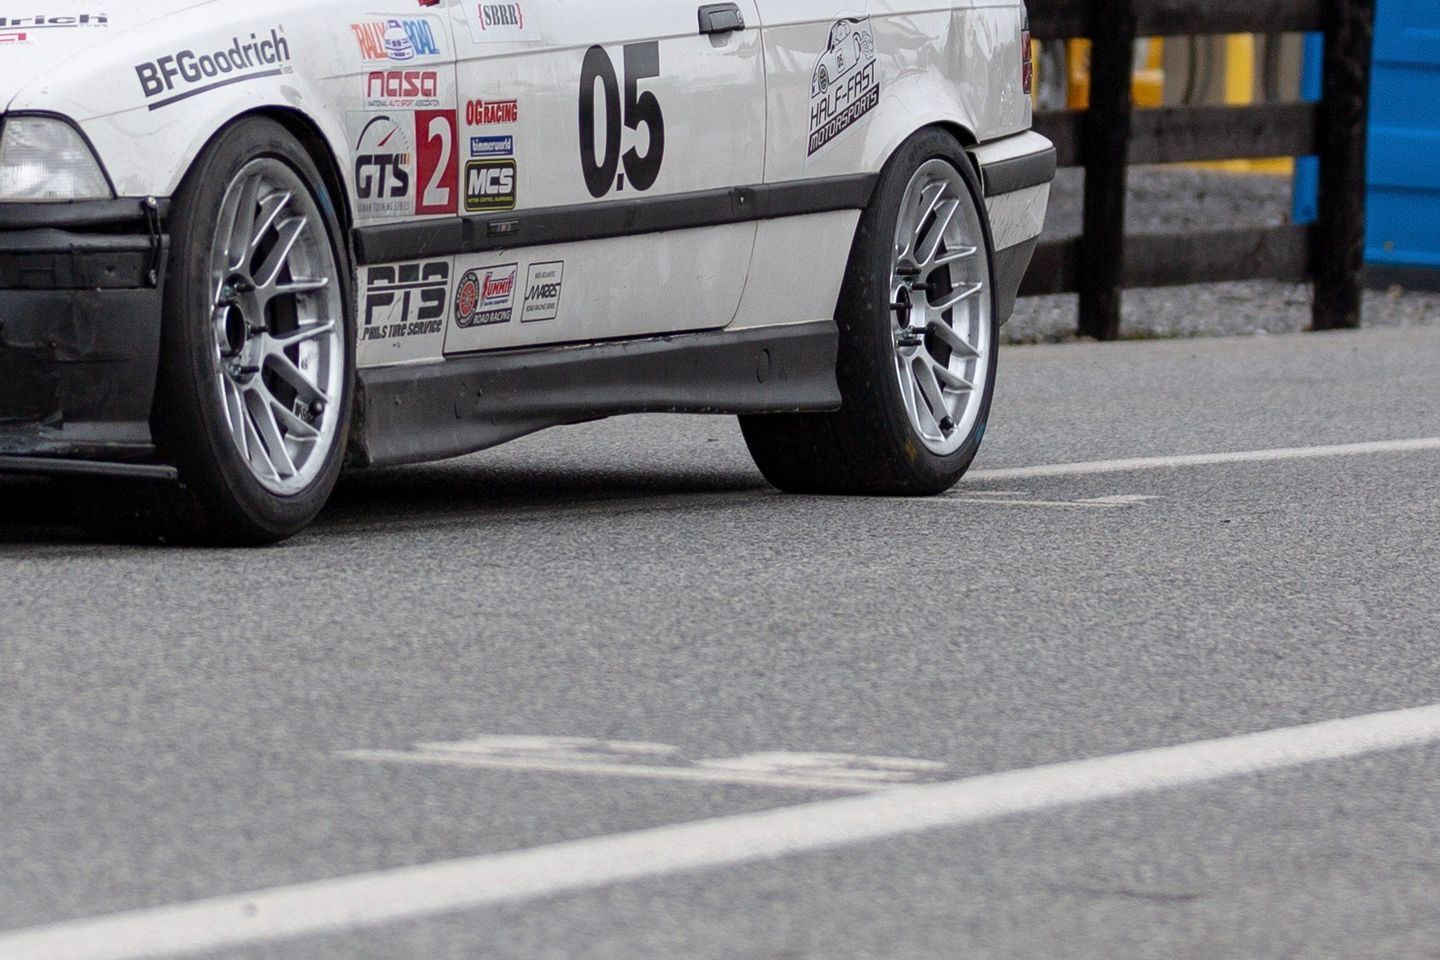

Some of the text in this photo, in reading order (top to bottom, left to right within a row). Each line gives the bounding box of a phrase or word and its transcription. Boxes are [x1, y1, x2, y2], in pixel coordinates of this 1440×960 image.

[135, 28, 290, 98] BFGoodrich
[367, 71, 437, 97] nasa
[810, 58, 877, 132] HALF-FAST
[809, 86, 879, 153] MOTORSPORTS
[355, 116, 453, 207] GTS 2
[468, 168, 514, 195] MCS
[364, 261, 450, 325] PTS
[490, 309, 512, 322] RACING
